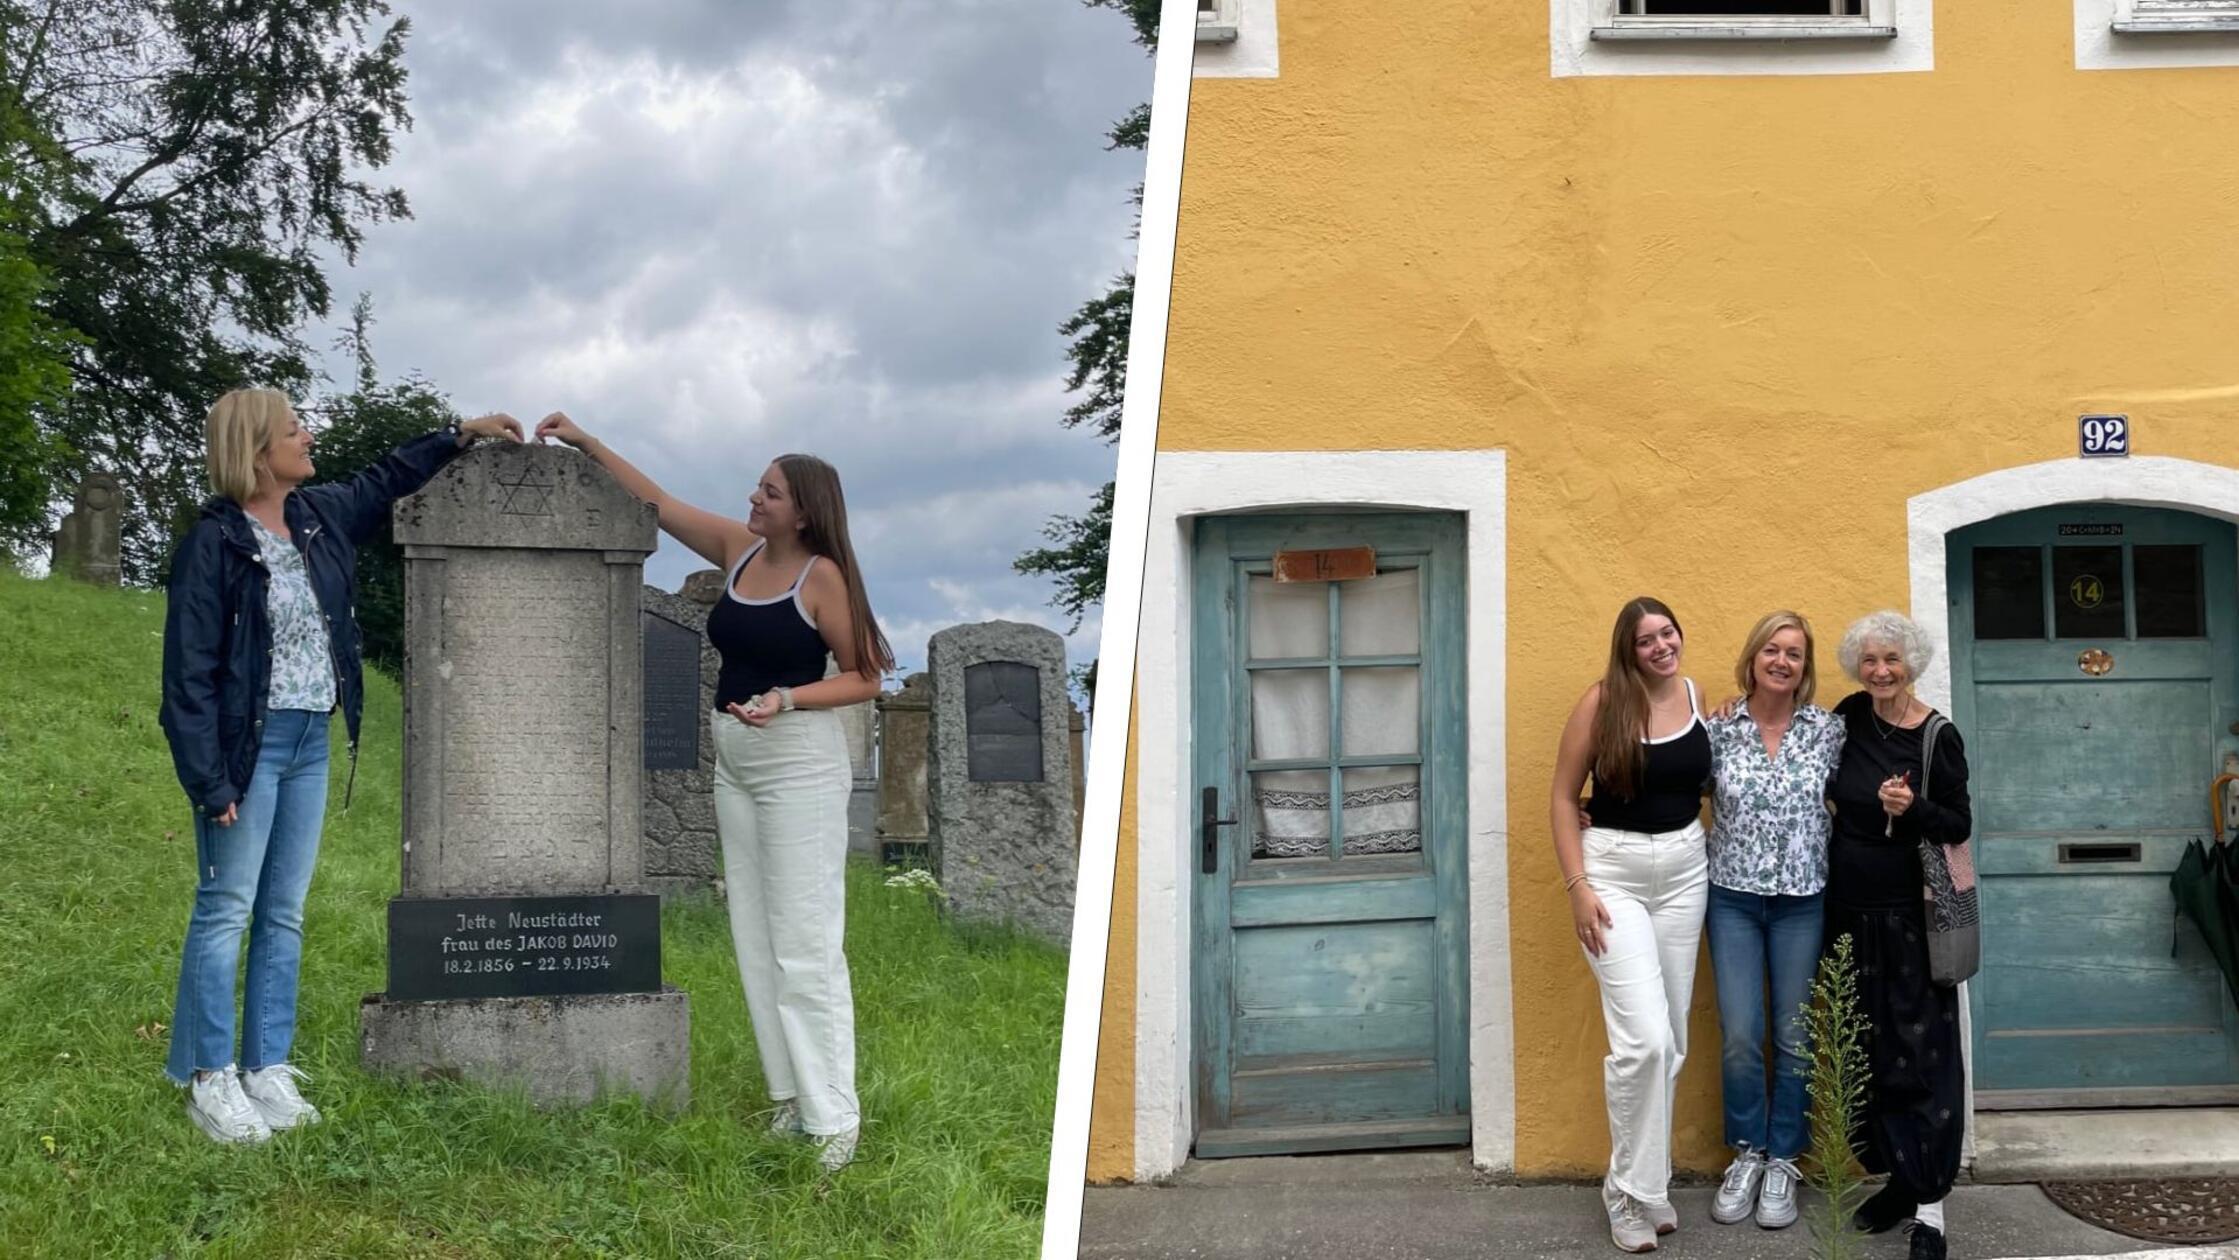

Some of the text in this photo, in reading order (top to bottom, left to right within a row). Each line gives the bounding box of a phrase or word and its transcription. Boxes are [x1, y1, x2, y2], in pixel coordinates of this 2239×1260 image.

[2084, 420, 2124, 451] 92
[1314, 552, 1336, 577] 14
[2072, 582, 2100, 602] 14
[457, 912, 601, 932] Jette Neustädter
[485, 937, 512, 951] des
[517, 935, 567, 951] JAKOB
[573, 934, 617, 948] DAVID
[445, 958, 515, 973] 18.2.1856
